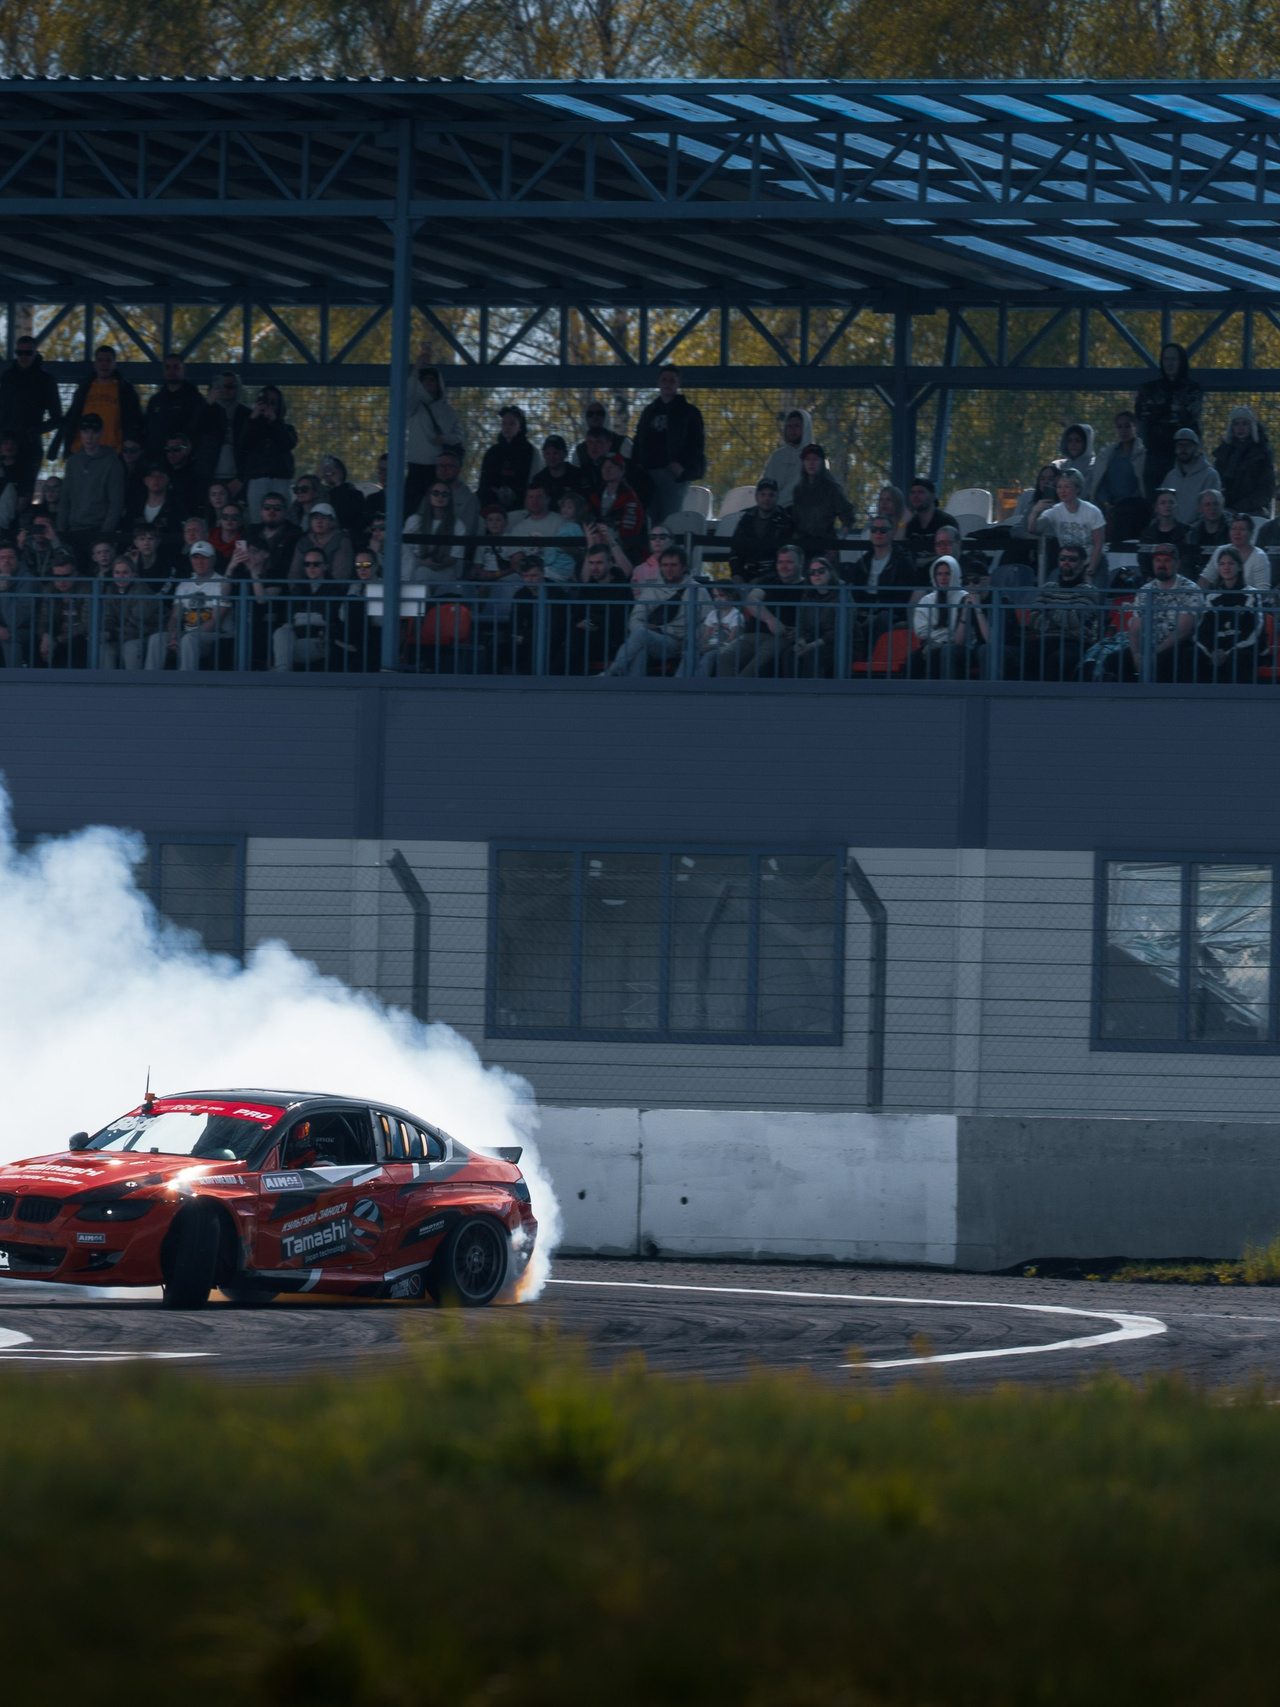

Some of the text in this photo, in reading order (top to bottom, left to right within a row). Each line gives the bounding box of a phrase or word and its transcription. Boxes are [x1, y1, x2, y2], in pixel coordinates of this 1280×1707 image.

[232, 1108, 272, 1120] PRO
[265, 1176, 302, 1189] AIMOL
[282, 1219, 347, 1257] Tamashi
